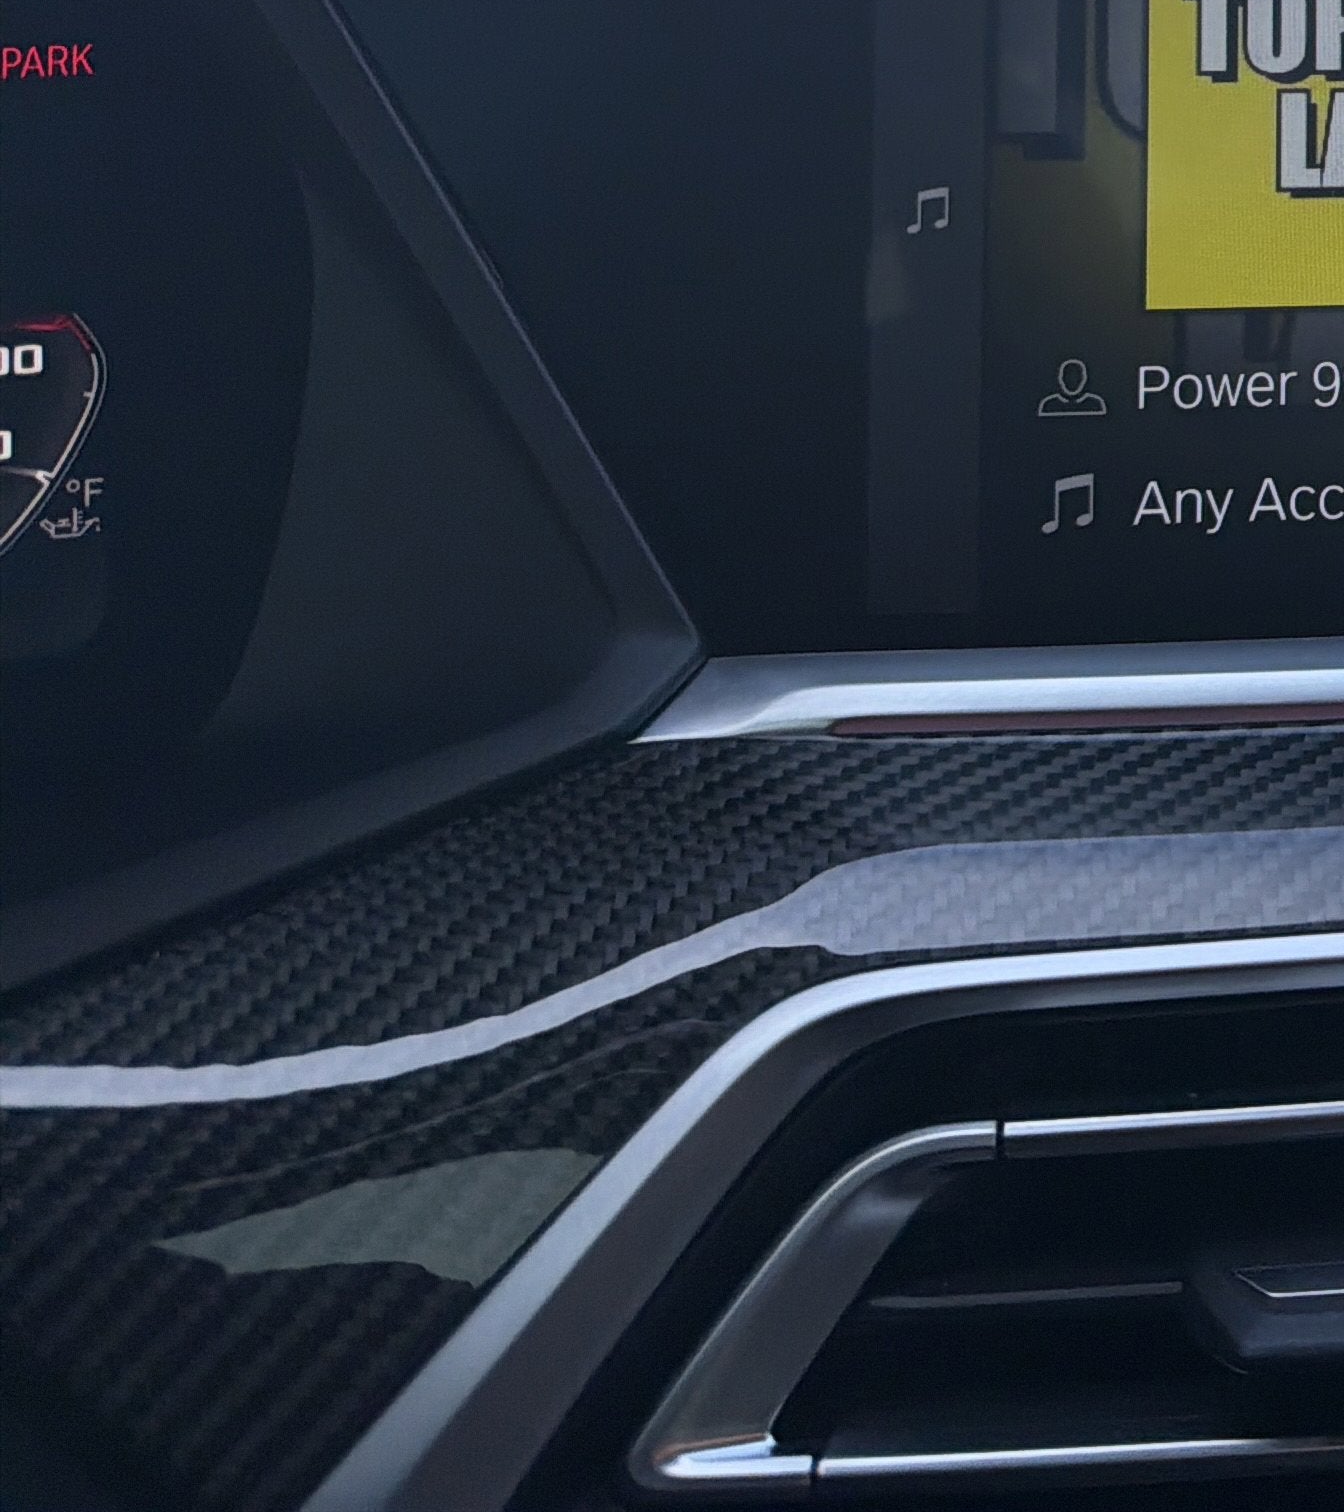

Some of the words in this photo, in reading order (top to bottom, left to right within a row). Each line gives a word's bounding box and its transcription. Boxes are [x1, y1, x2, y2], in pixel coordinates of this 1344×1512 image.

[2, 44, 92, 79] PARK
[1139, 366, 1297, 409] Power
[1133, 481, 1233, 534] Any
